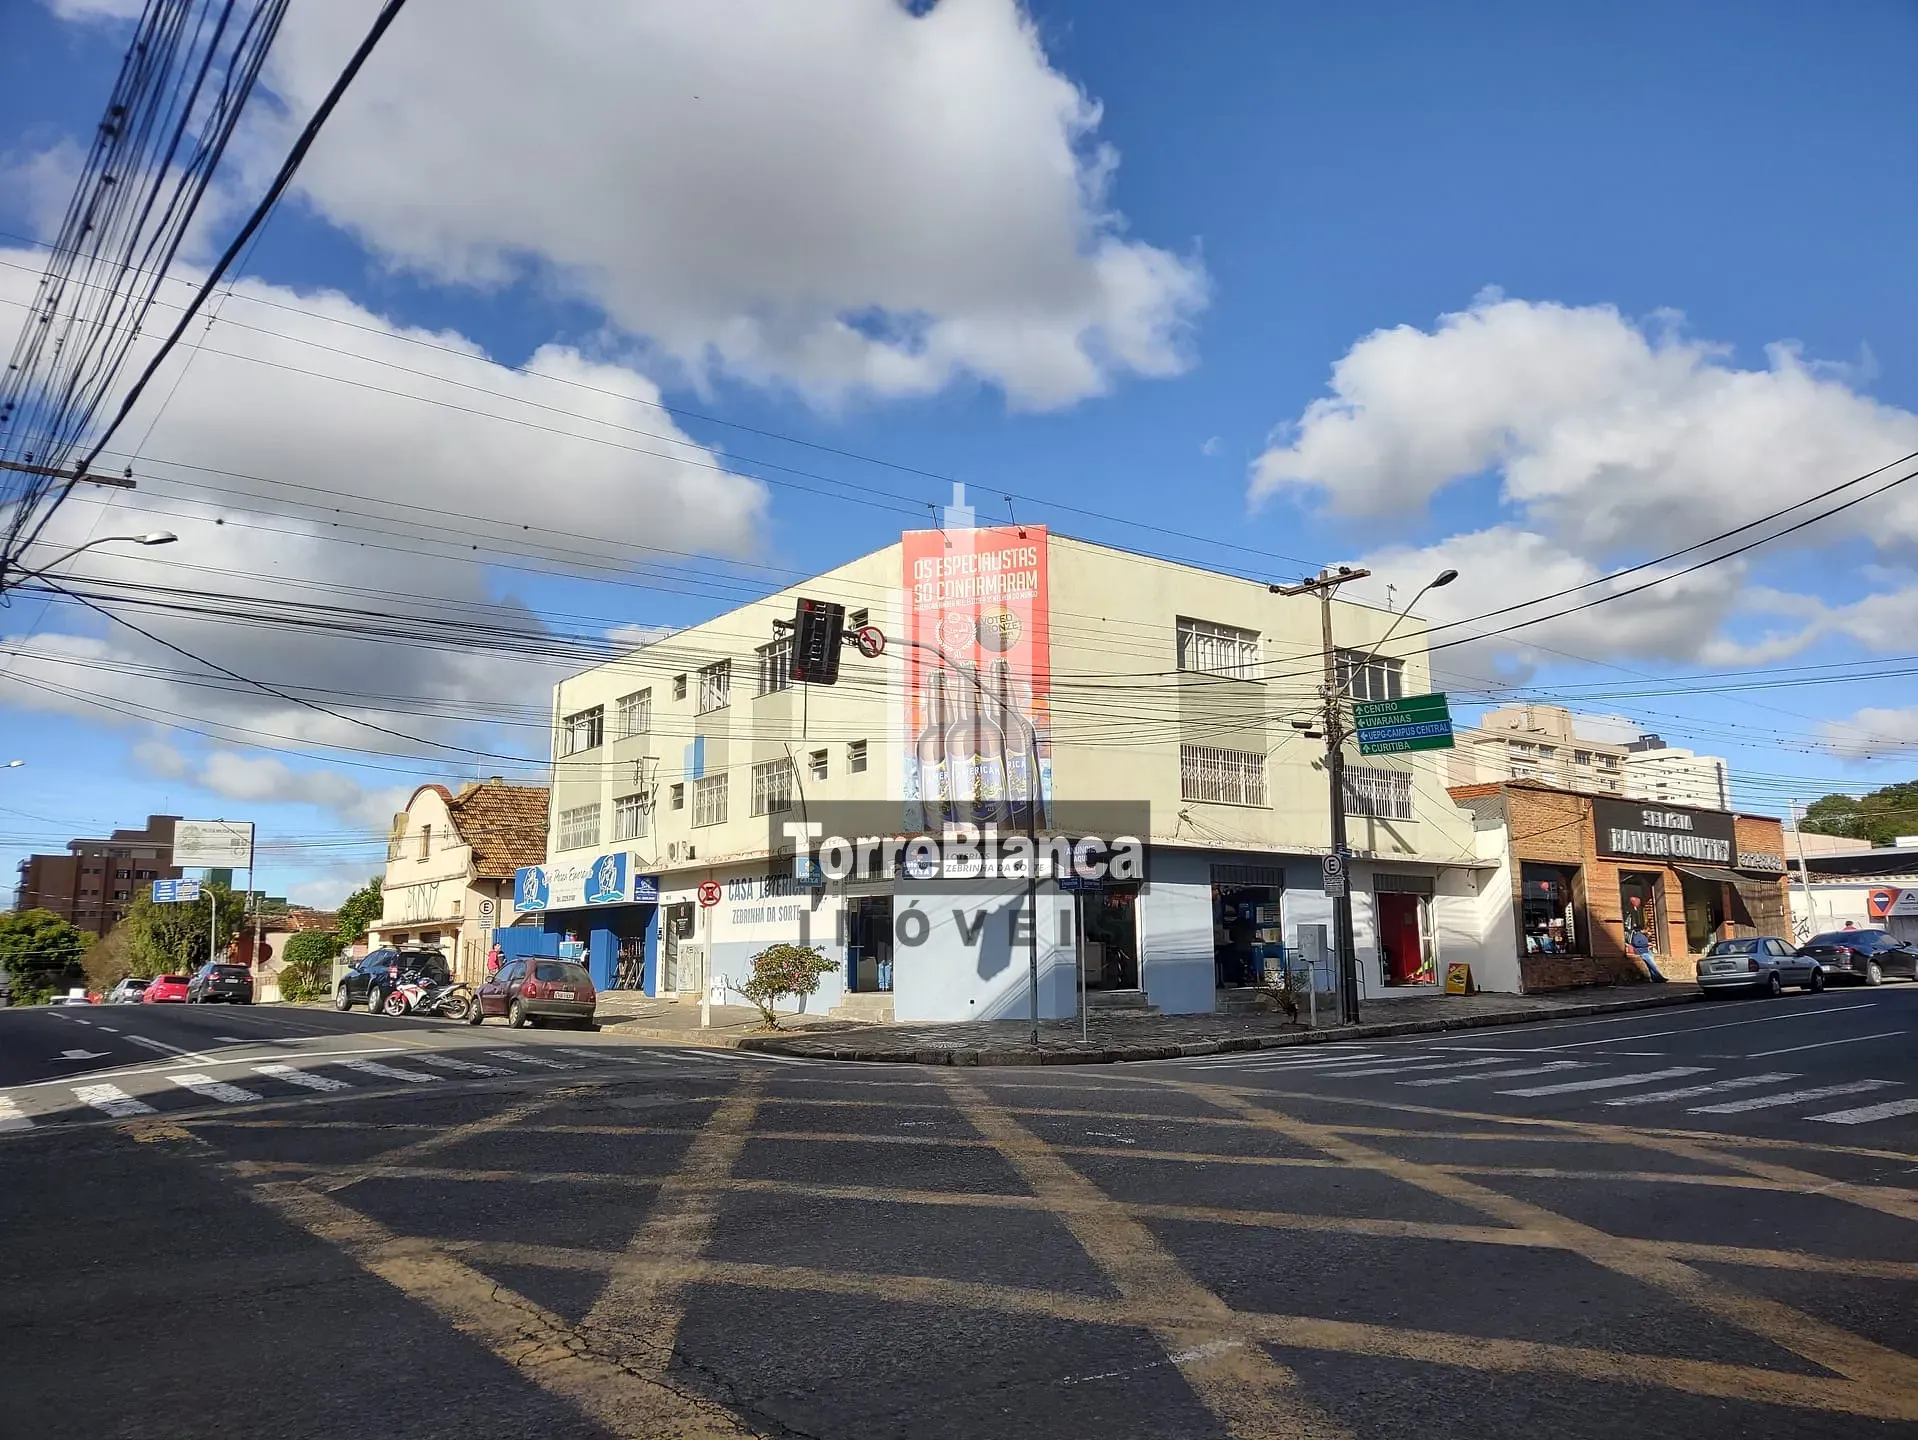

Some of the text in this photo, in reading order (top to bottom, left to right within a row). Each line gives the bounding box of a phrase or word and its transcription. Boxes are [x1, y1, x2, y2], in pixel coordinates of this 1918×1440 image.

[914, 547, 1037, 580] OS ESPECIALISTAS
[914, 570, 1038, 603] SÓ CONFIRMARAM
[981, 614, 1012, 625] VOTED
[1363, 702, 1398, 714] CENTRO
[1365, 713, 1412, 726] UVARANAS
[1416, 722, 1449, 735] CENTRAL
[1371, 740, 1411, 753] CURITIBA
[945, 863, 1045, 873] ZEBRINHA DA SOTE
[1329, 859, 1337, 871] E
[728, 878, 753, 900] CASA
[483, 902, 490, 912] E
[732, 904, 801, 925] ZEBRINHA DA SORTE
